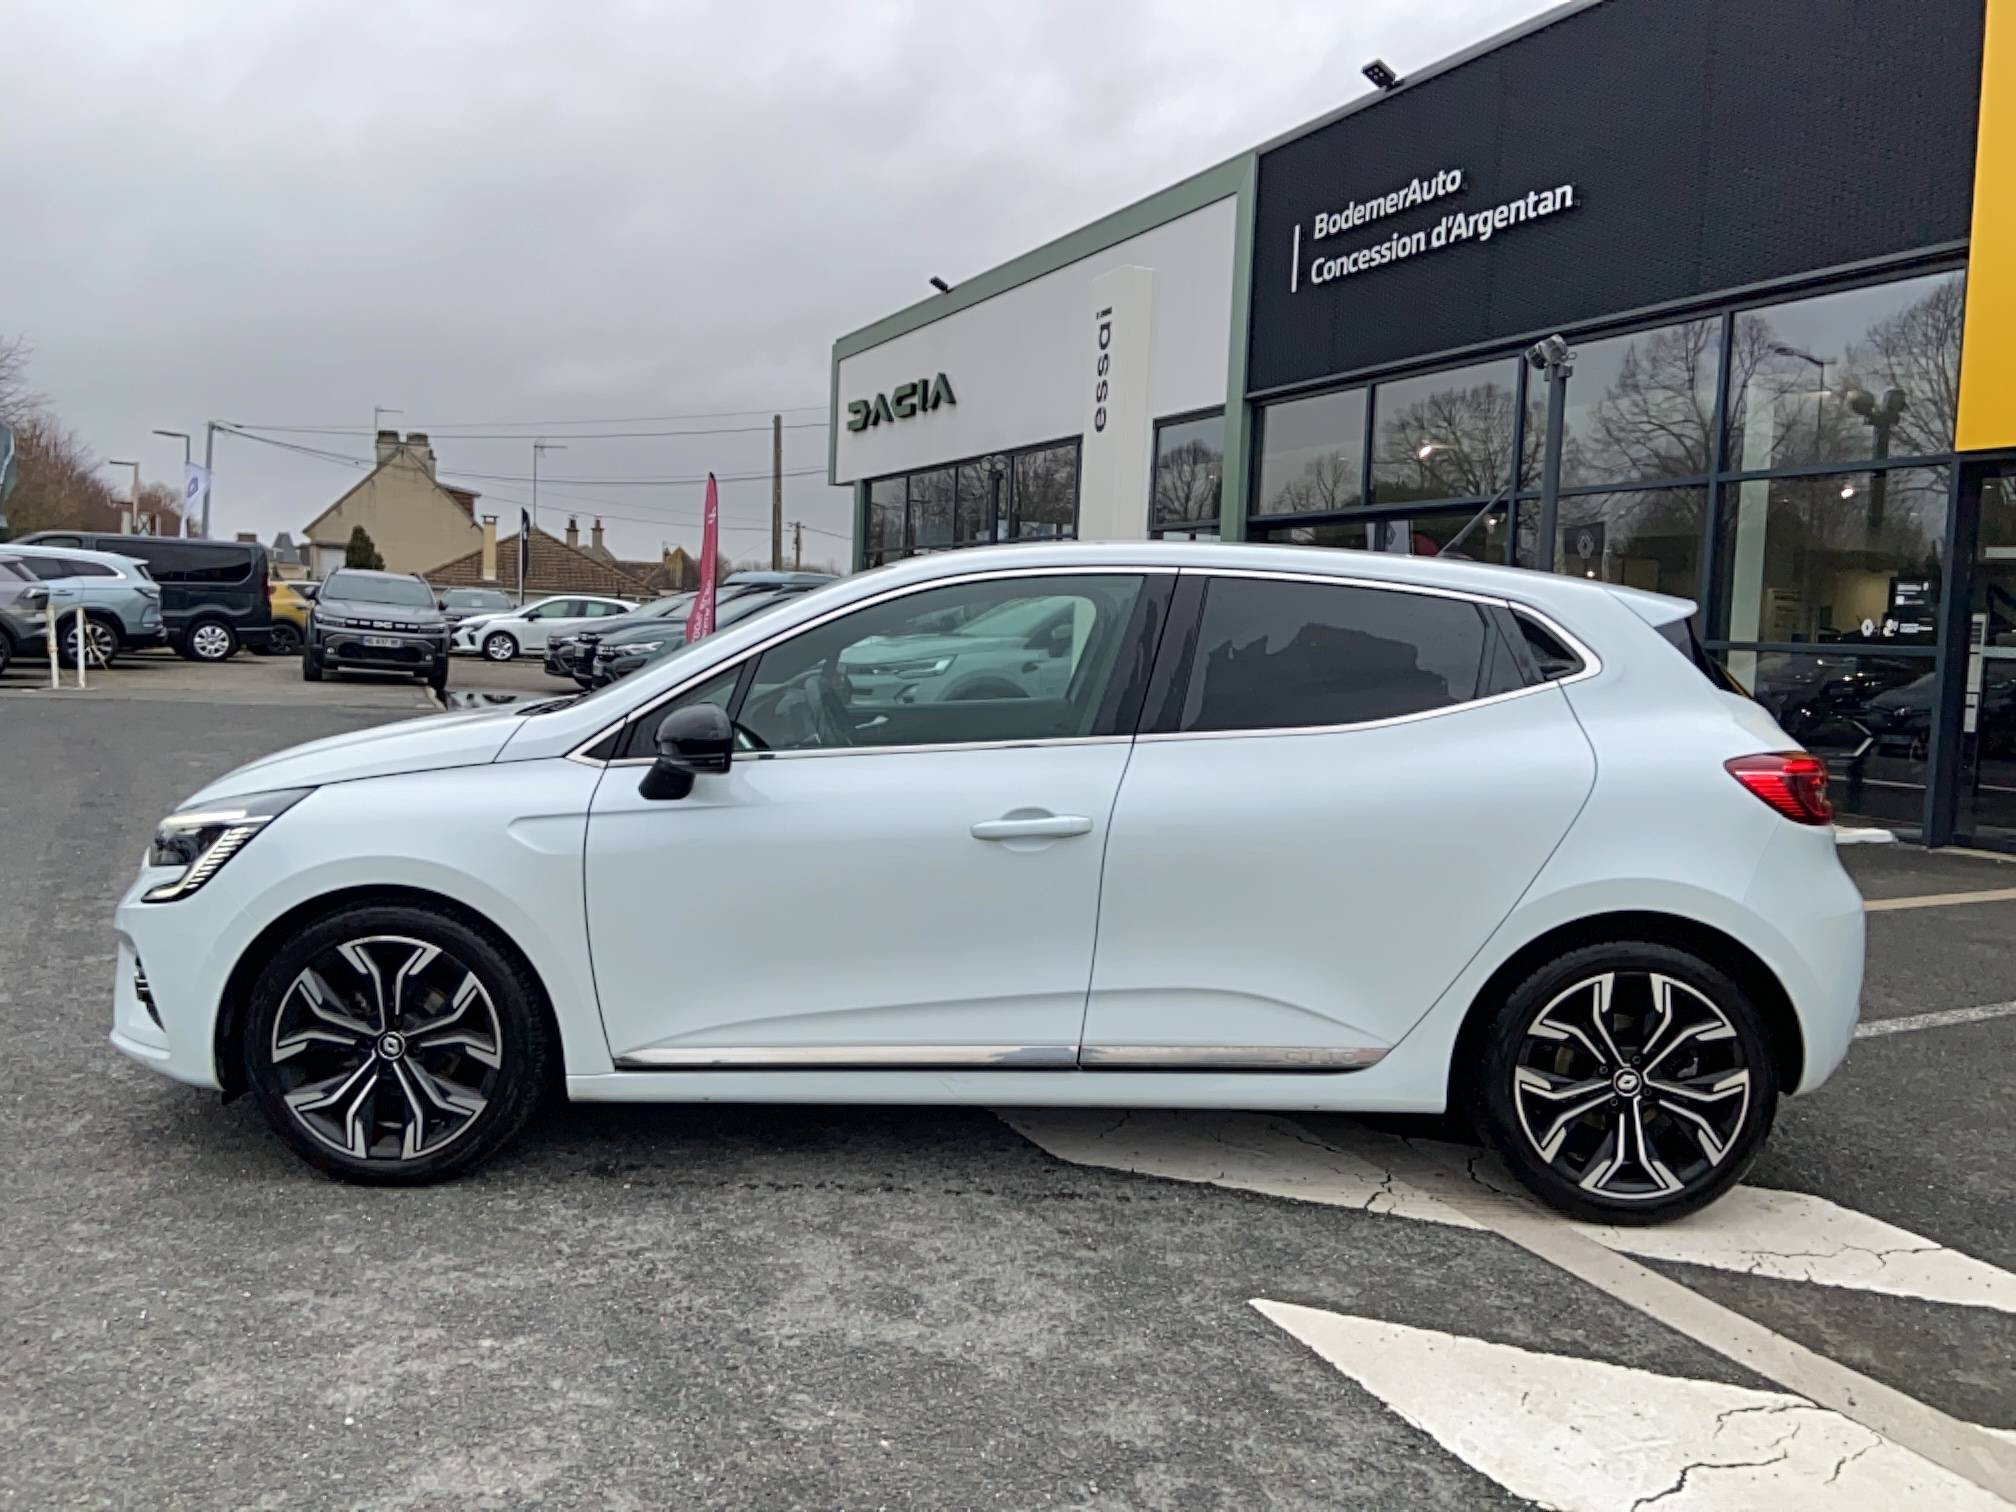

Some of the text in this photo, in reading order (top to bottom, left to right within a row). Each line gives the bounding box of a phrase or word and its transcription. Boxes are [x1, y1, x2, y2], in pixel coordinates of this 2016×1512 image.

[1311, 184, 1574, 285] Concession d'Argentan
[1314, 168, 1462, 240] BodemerAuto
[847, 372, 957, 433] DACIA
[1095, 306, 1113, 433] essai
